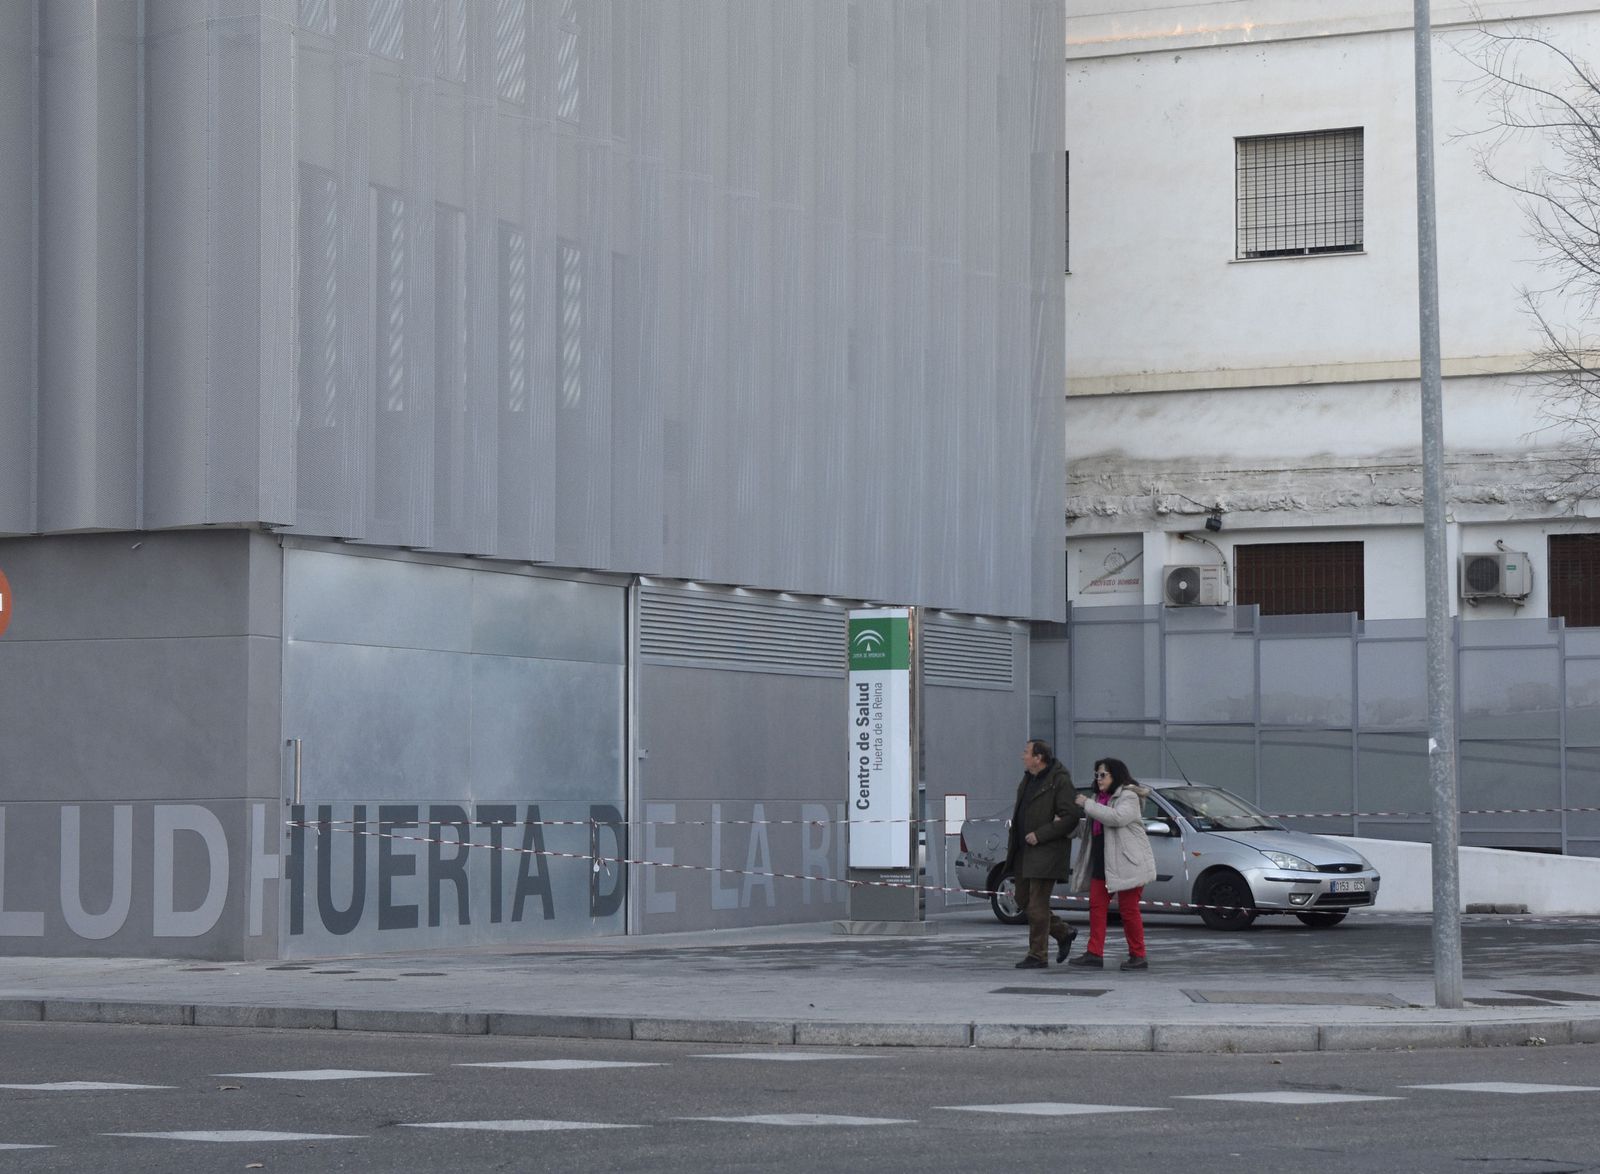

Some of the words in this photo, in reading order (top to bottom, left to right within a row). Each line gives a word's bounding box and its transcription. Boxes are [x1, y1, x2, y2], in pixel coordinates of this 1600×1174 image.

[856, 682, 870, 727] Salud
[873, 682, 883, 709] Reina
[873, 712, 883, 721] la
[873, 723, 883, 736] de
[856, 732, 870, 751] de
[873, 738, 883, 771] Huerta
[856, 756, 870, 810] Centro
[250, 804, 555, 937] HUERTA
[588, 804, 677, 918] DE
[711, 804, 776, 910] LA
